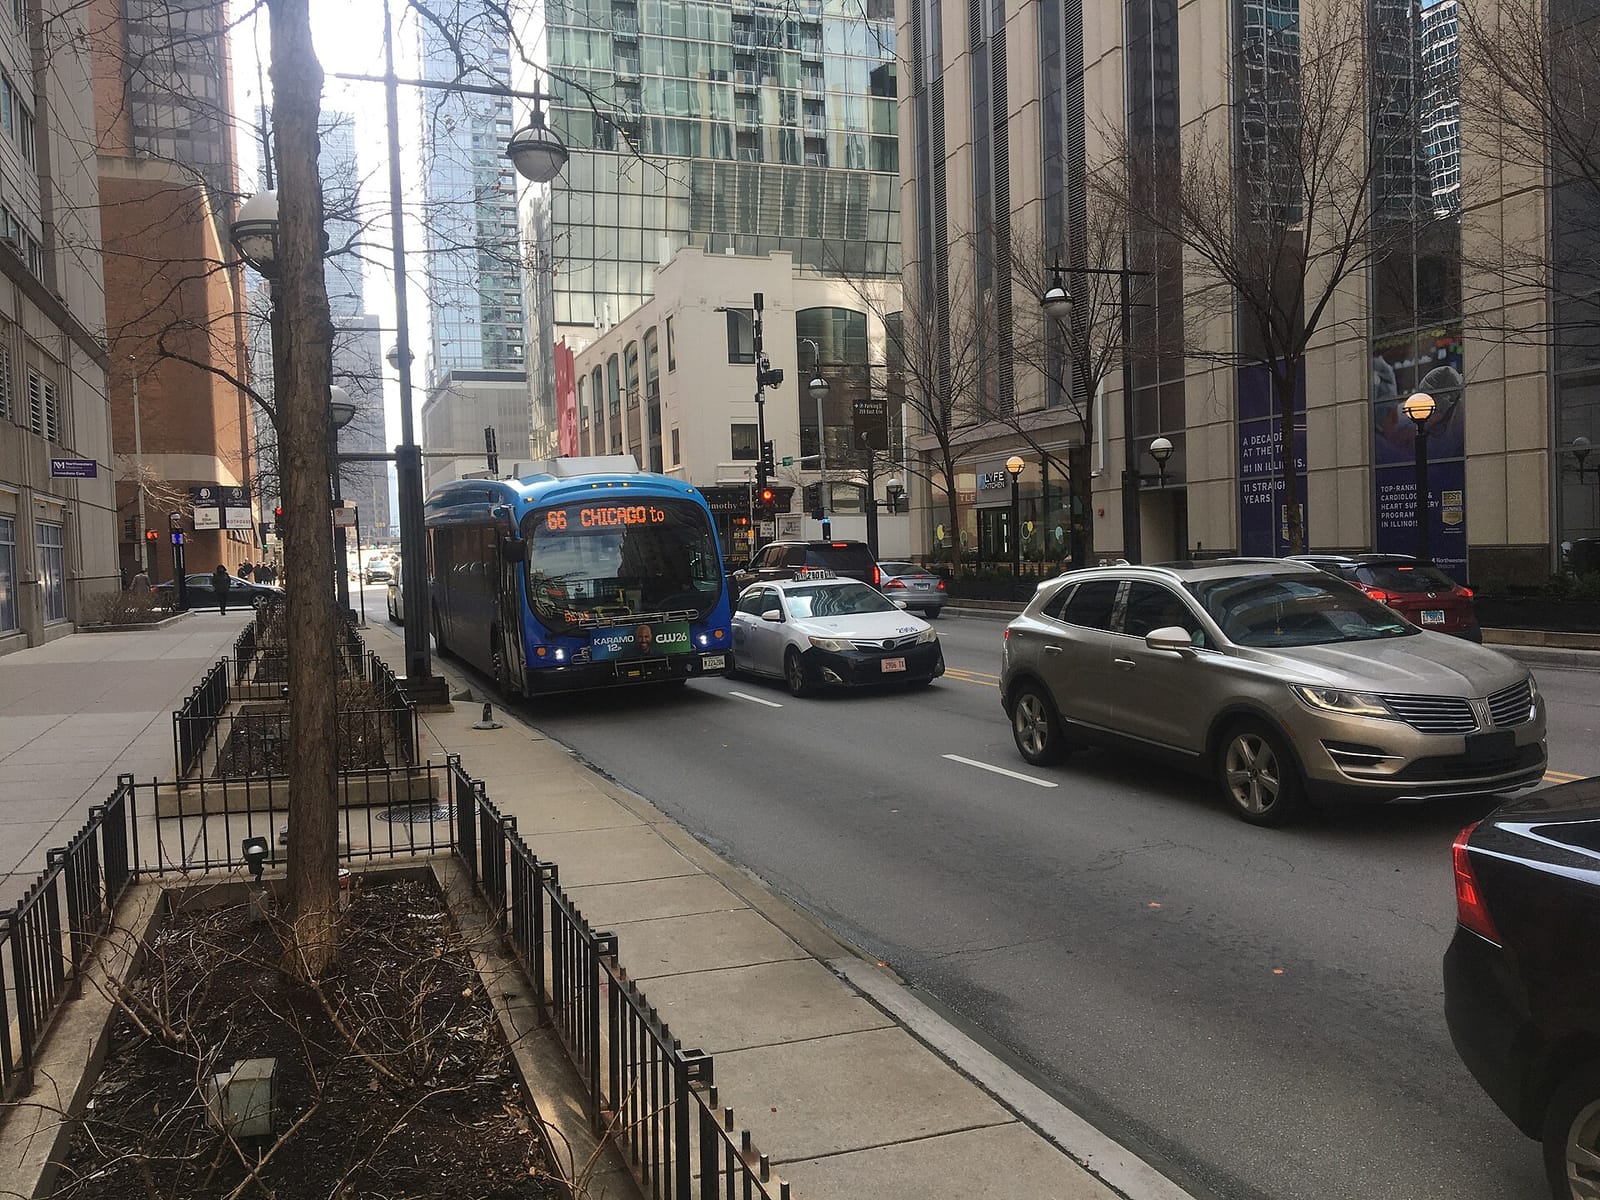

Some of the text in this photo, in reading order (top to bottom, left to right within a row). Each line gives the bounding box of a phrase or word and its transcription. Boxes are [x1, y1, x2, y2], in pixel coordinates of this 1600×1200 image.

[1243, 437, 1248, 446] A
[1243, 448, 1252, 458] AT
[1256, 446, 1272, 456] THE
[1244, 464, 1252, 472] #1
[1254, 464, 1262, 472] IN
[984, 471, 1004, 482] LYFE
[1244, 484, 1250, 492] 11
[708, 501, 737, 510] imothy
[546, 506, 665, 530] 66 CHICAGO to
[594, 635, 634, 645] KARAMO
